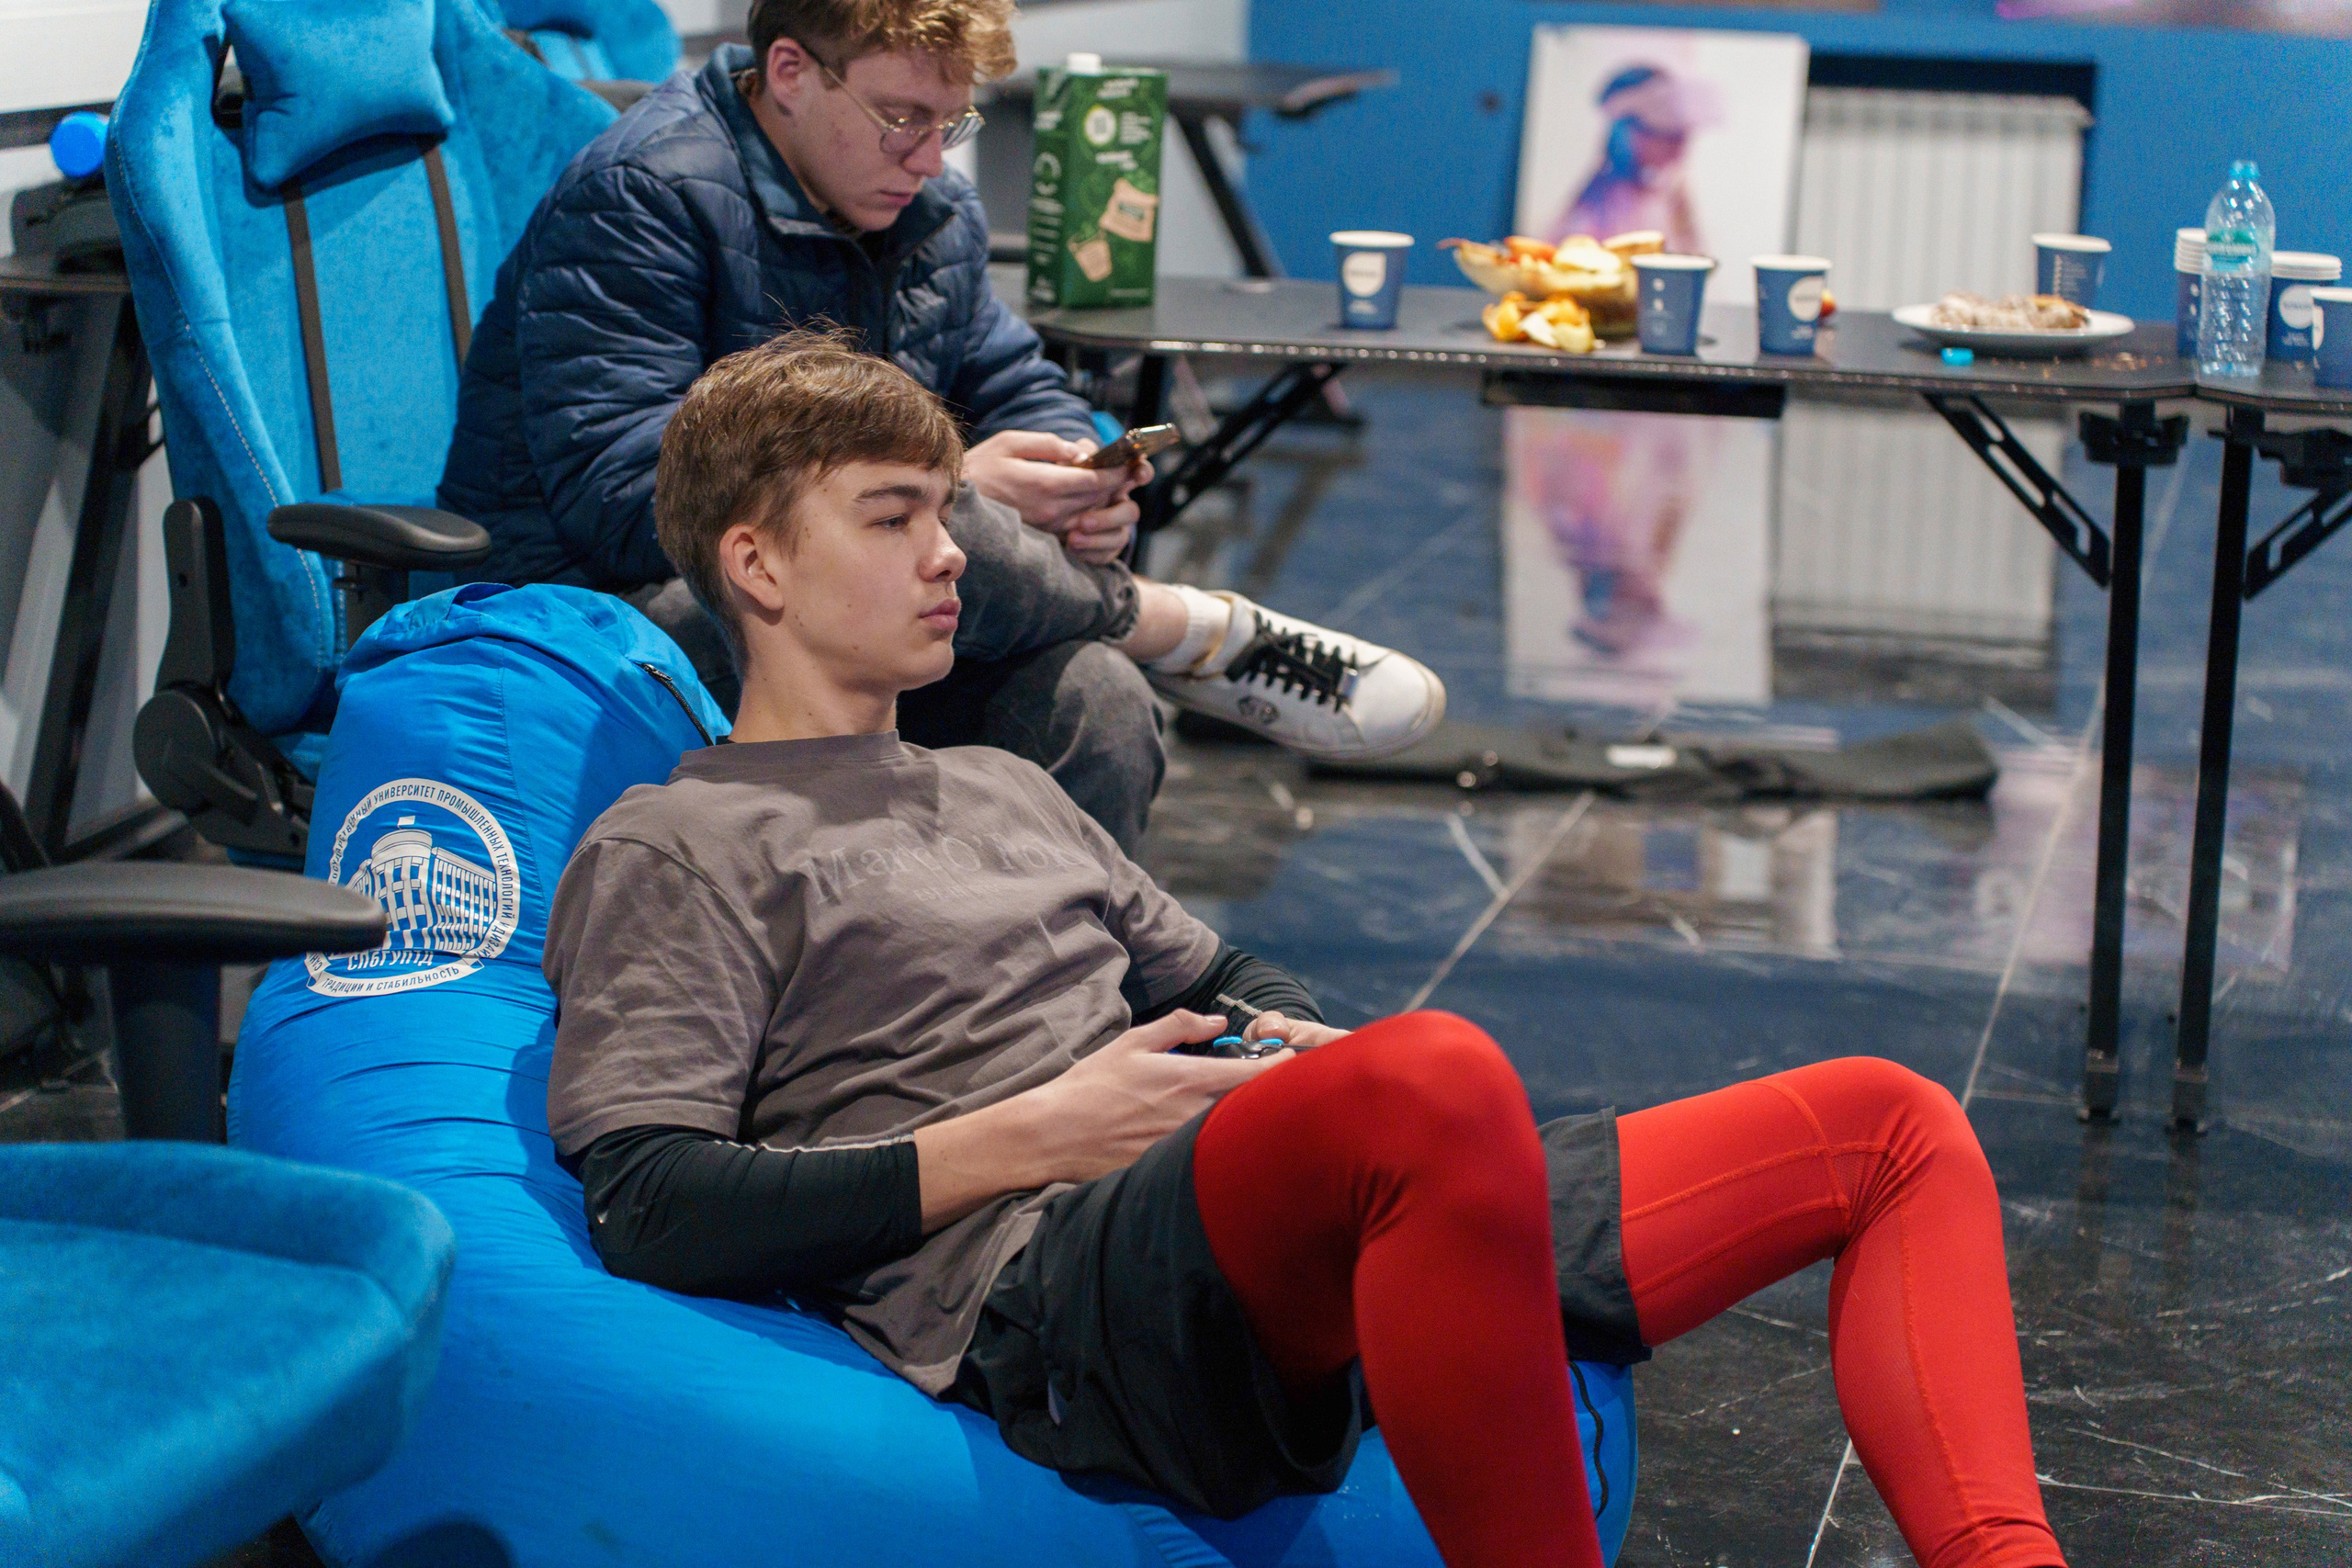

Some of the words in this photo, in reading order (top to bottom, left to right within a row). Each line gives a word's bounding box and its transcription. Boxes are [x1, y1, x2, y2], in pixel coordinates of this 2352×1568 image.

[374, 784, 436, 804] УНИВЕРСИТЕТ
[436, 789, 505, 852] ПРОМЫШЛЕННЫХ
[496, 852, 515, 919] ТЕХНОЛОГИЙ
[346, 950, 435, 971] СПбГУПТД
[322, 977, 365, 994] ТРАДИЦИИ
[366, 982, 374, 992] И
[376, 965, 460, 991] СТАБИЛЬНОСТЬ
